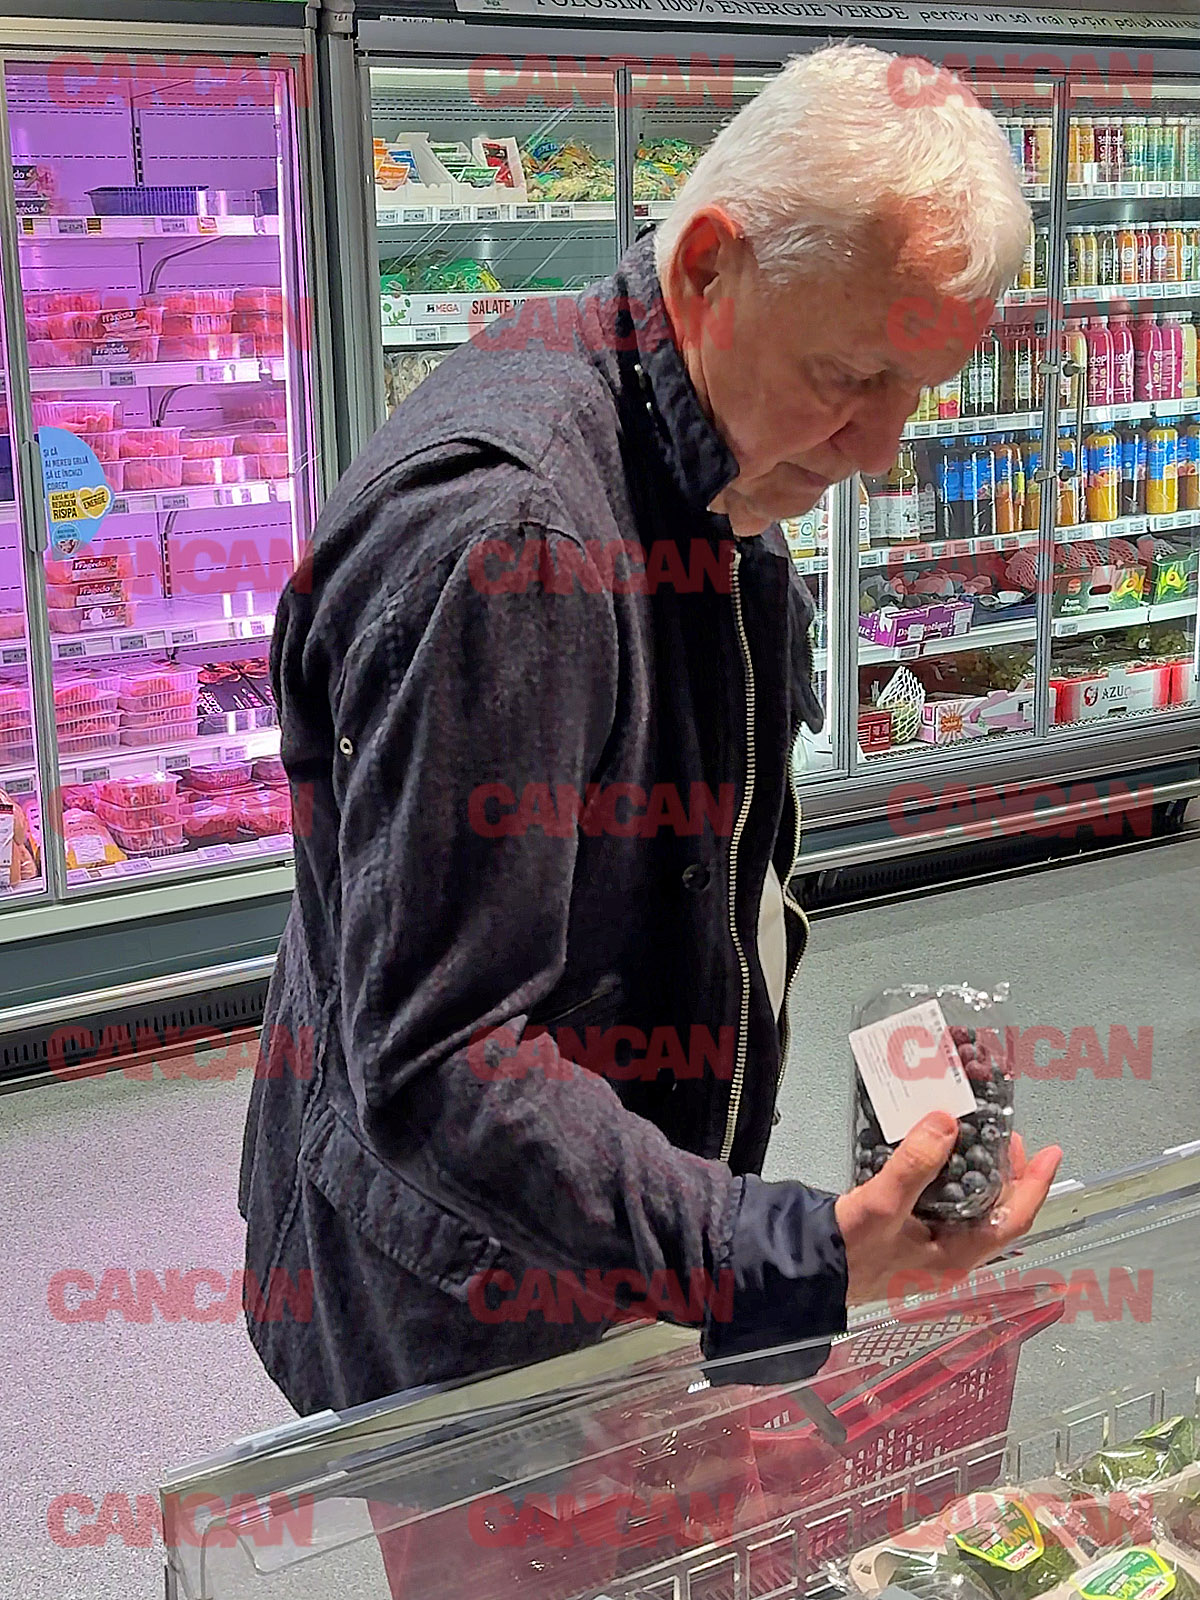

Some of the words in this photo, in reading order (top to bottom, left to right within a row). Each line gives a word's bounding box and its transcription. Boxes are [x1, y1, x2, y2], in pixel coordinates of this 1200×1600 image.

[657, 0, 714, 13] 100%
[715, 0, 826, 17] ENERGIE
[825, 4, 909, 20] VERDE
[919, 10, 979, 24] pentru
[983, 13, 1007, 23] un
[1009, 12, 1032, 24] sol
[1036, 15, 1065, 25] mai
[472, 299, 510, 315] SALATE
